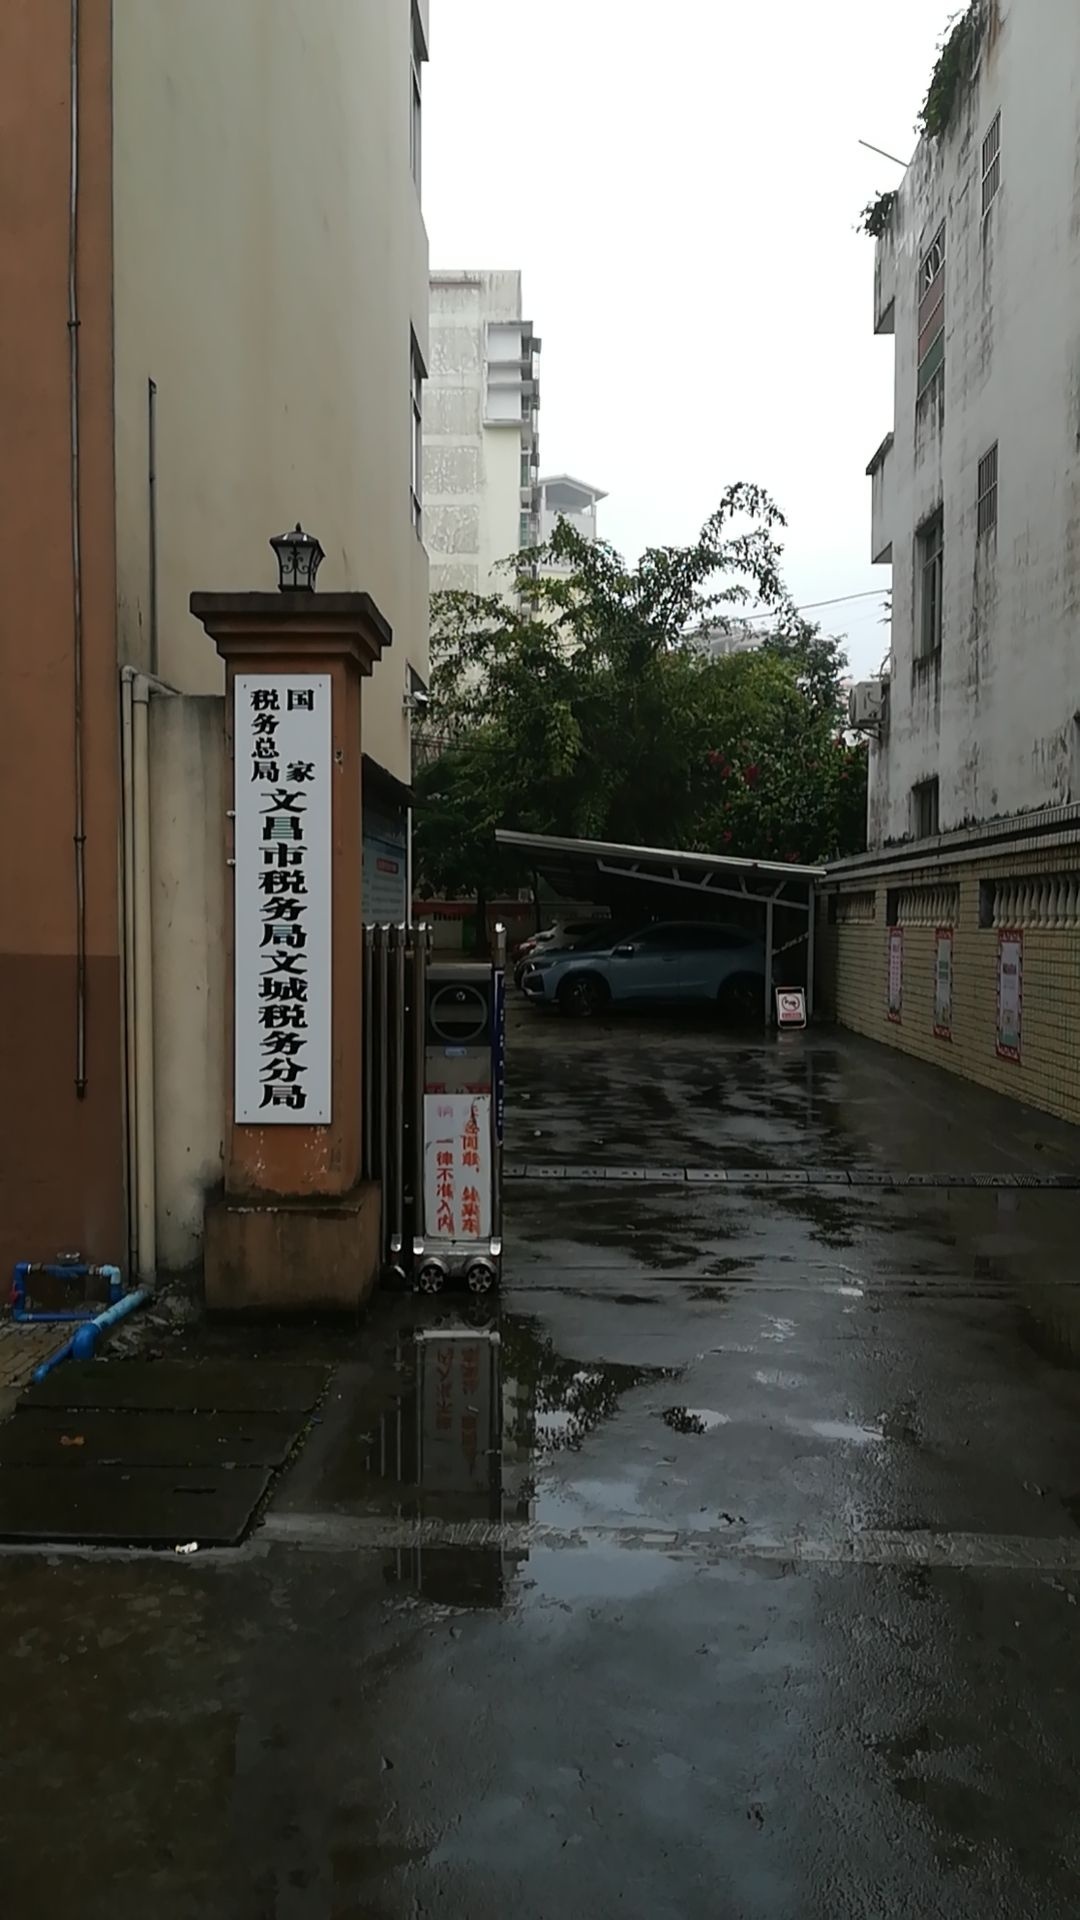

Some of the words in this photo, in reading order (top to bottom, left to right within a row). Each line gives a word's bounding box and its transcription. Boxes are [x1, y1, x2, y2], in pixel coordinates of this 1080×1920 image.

[250, 689, 280, 783] 税务总局
[258, 788, 308, 1110] 文昌市税务局文城税务分局
